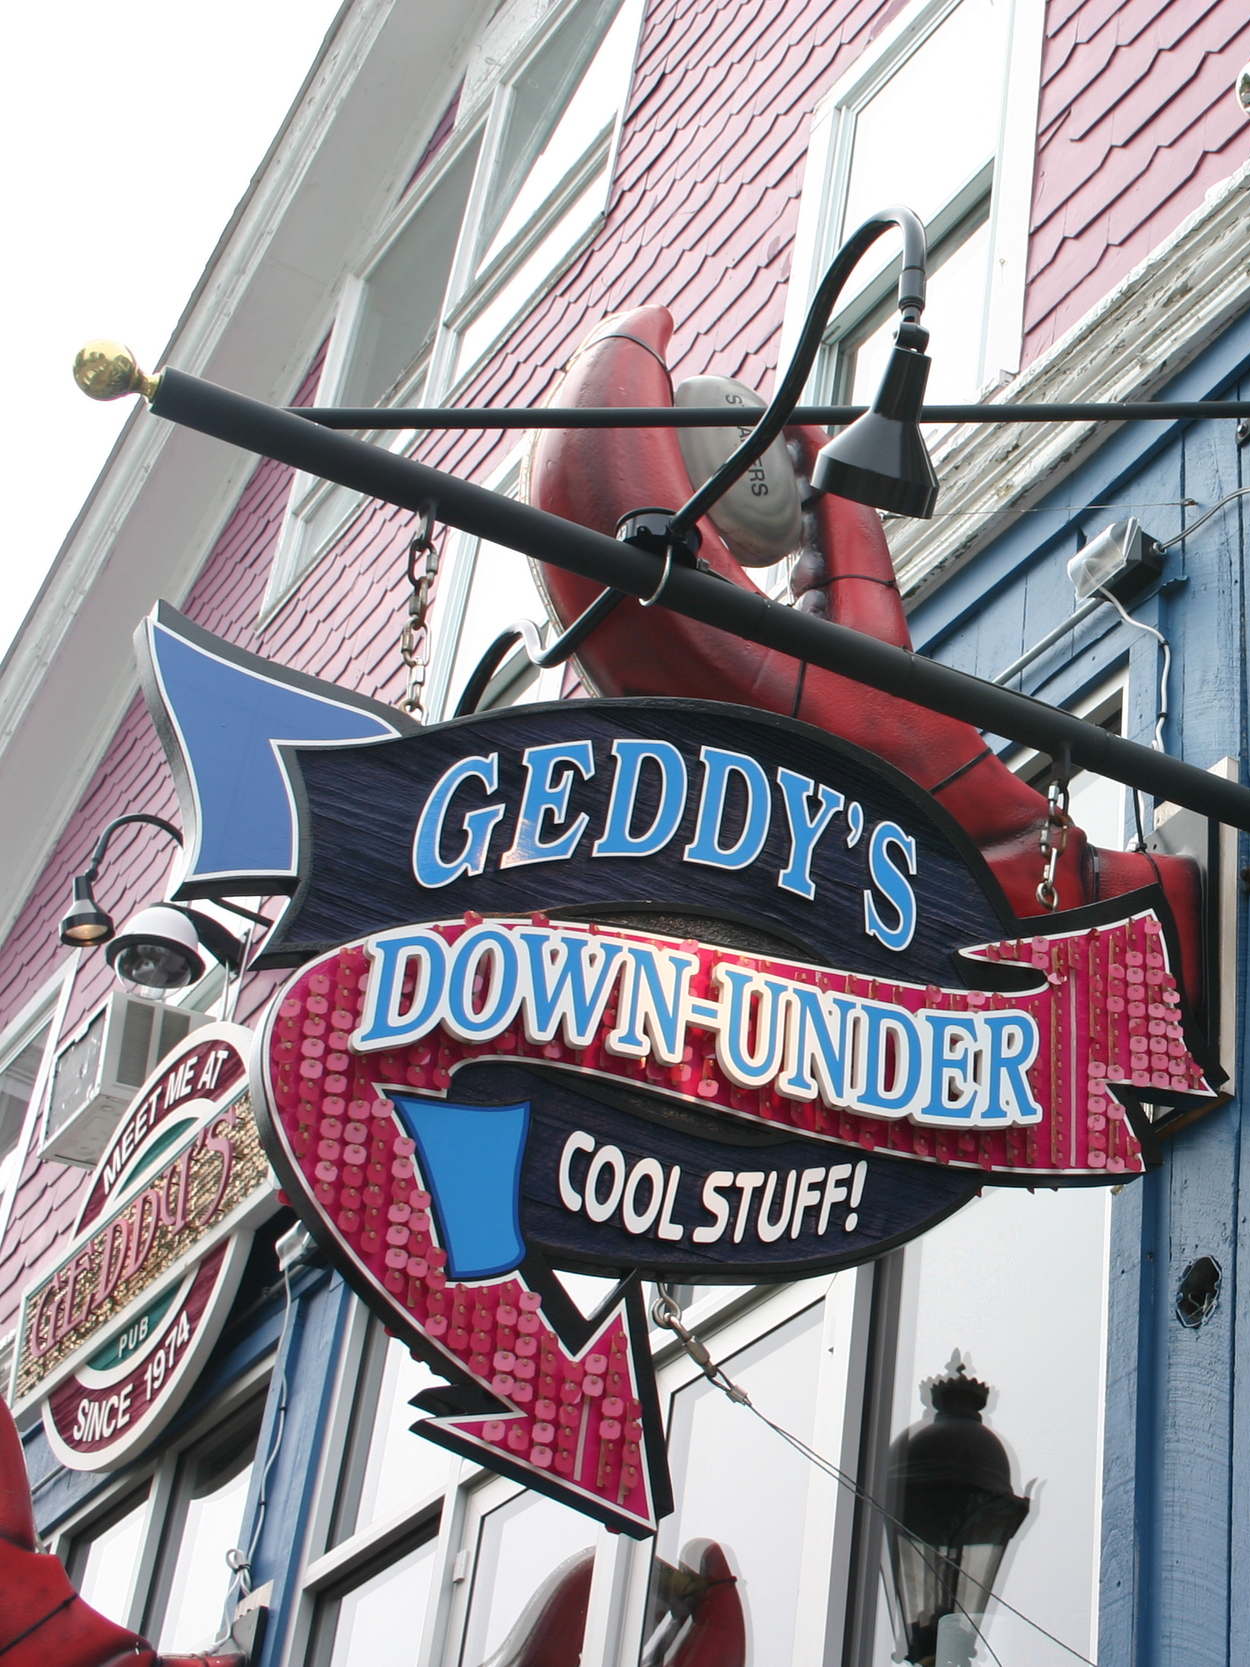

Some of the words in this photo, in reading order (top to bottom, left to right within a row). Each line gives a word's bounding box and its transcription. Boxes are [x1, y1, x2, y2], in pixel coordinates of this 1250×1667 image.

[412, 737, 918, 952] GEDDY'S
[348, 919, 1044, 1128] DOWN-UNDER
[103, 1085, 165, 1197] MEET
[164, 1063, 198, 1110] ME
[196, 1049, 229, 1091] AT
[557, 1130, 685, 1241] COOL
[691, 1160, 869, 1246] STUFF!
[73, 1384, 135, 1443] SINCE
[144, 1311, 192, 1402] 1974
[117, 1315, 150, 1359] PUB
